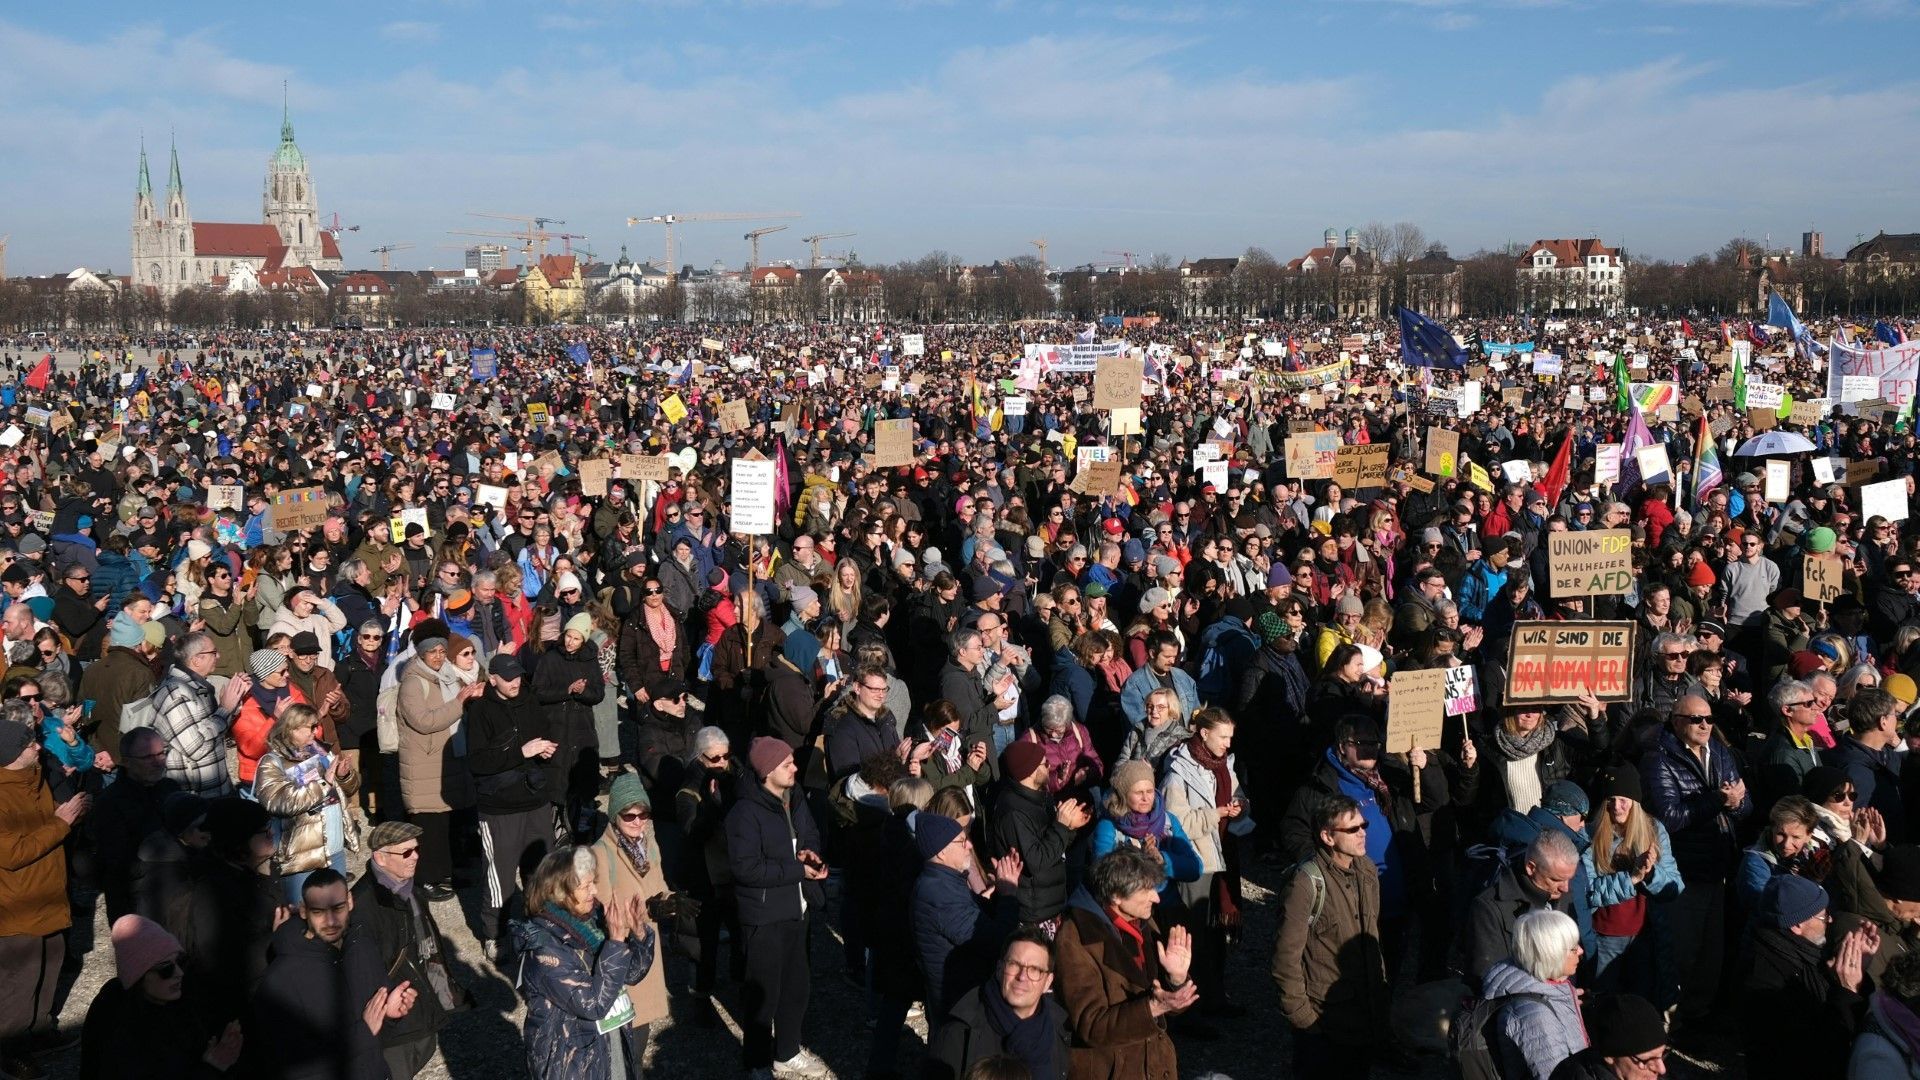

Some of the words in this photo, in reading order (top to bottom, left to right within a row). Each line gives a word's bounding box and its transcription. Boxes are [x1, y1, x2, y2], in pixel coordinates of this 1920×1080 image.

[1749, 384, 1774, 393] NAZIS
[1080, 449, 1106, 459] VIEL
[1353, 445, 1374, 455] JESUS
[275, 516, 299, 528] RECHTE
[1602, 535, 1630, 554] FDP
[1554, 560, 1625, 572] WAHLHELFER
[1806, 557, 1826, 582] fck
[1557, 578, 1582, 588] DER
[1587, 571, 1632, 592] AFD
[1523, 630, 1547, 644] WIR
[1556, 632, 1589, 646] SIND
[1602, 631, 1623, 646] DIE
[1413, 672, 1424, 680] hat
[1446, 668, 1467, 685] LICE
[1513, 659, 1628, 693] BRANDMAUER!
